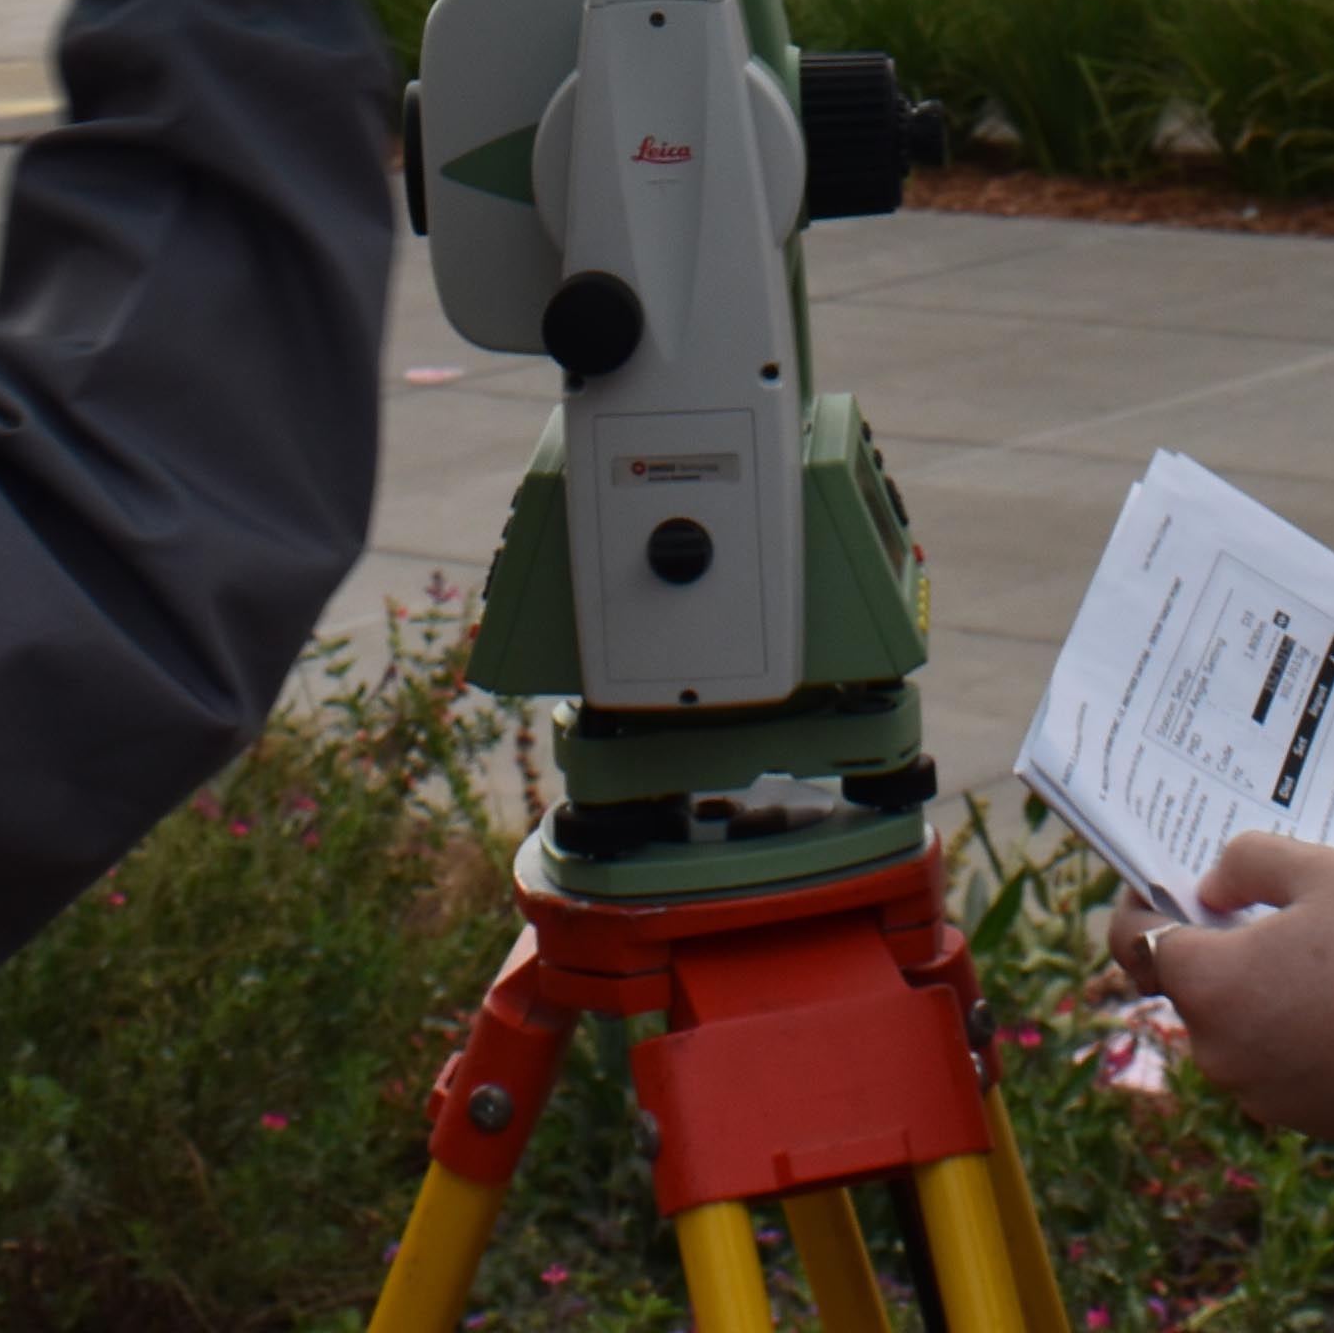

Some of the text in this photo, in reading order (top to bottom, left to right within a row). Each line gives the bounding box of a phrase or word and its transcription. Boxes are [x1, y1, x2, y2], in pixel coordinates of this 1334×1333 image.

[630, 134, 693, 164] Leica
[1156, 667, 1192, 737] Station Setup
[1173, 637, 1227, 746] Manual Angle Setting
[1293, 735, 1308, 757] Set
[1308, 684, 1328, 718] Input
[1217, 745, 1234, 772] Code
